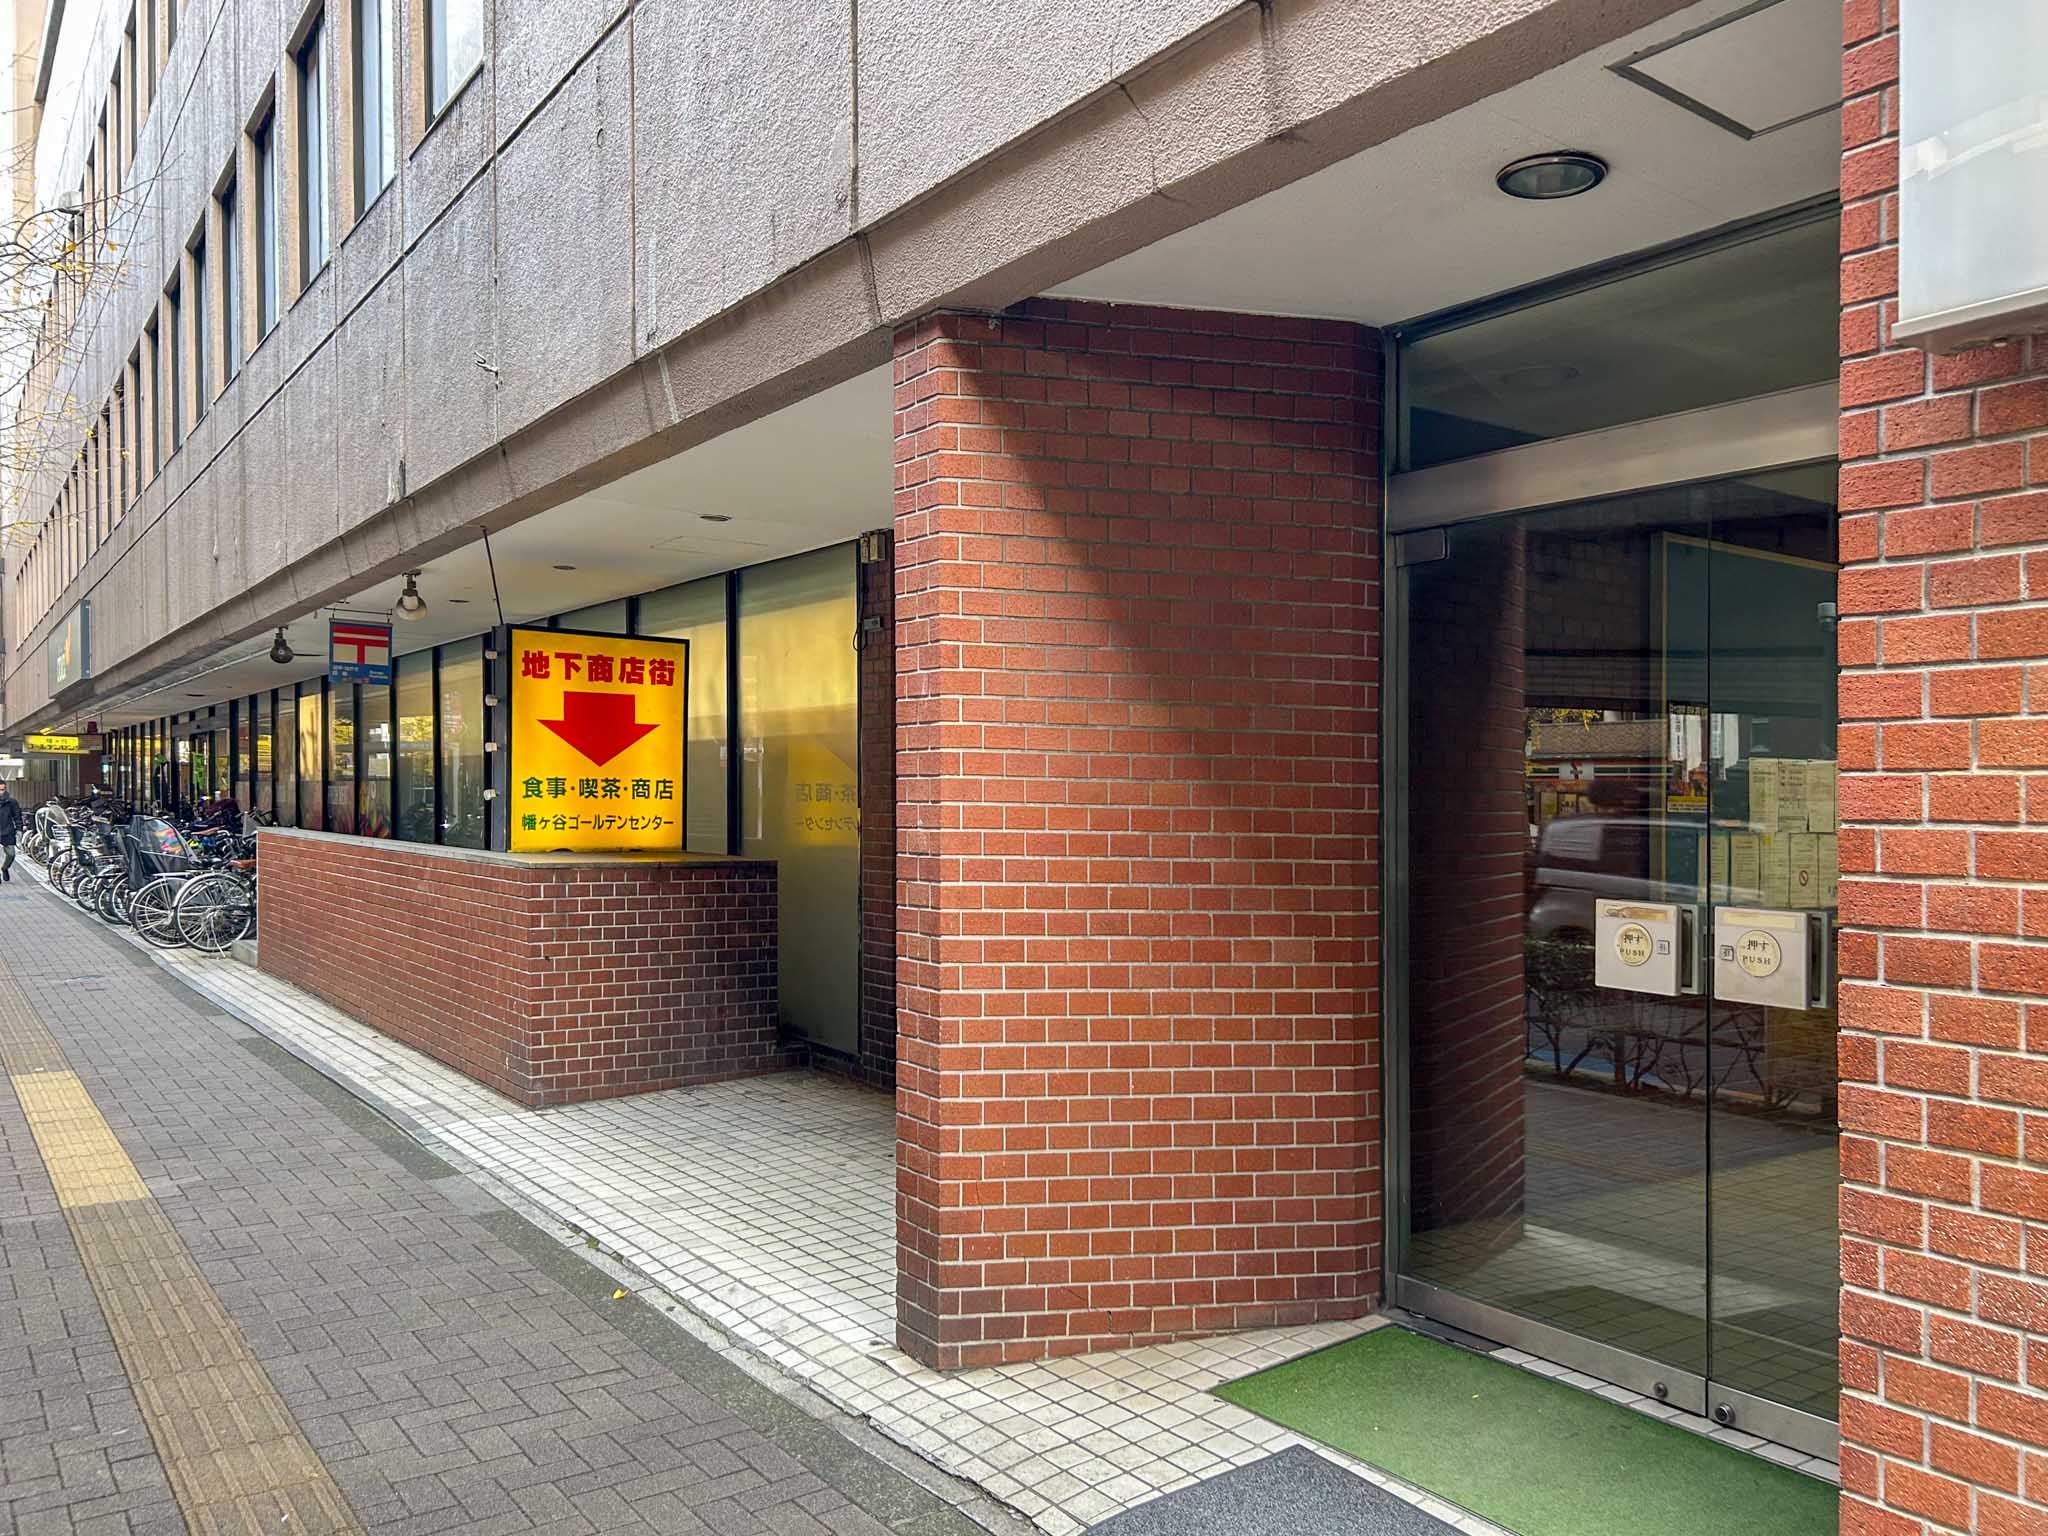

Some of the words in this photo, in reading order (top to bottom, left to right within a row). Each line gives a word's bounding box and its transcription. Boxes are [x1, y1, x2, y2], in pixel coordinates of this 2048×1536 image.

[521, 650, 675, 687] 地下商店街
[522, 776, 674, 800] 食事・喫茶・商店
[1619, 947, 1645, 957] PUSH
[1742, 954, 1771, 966] PUSH
